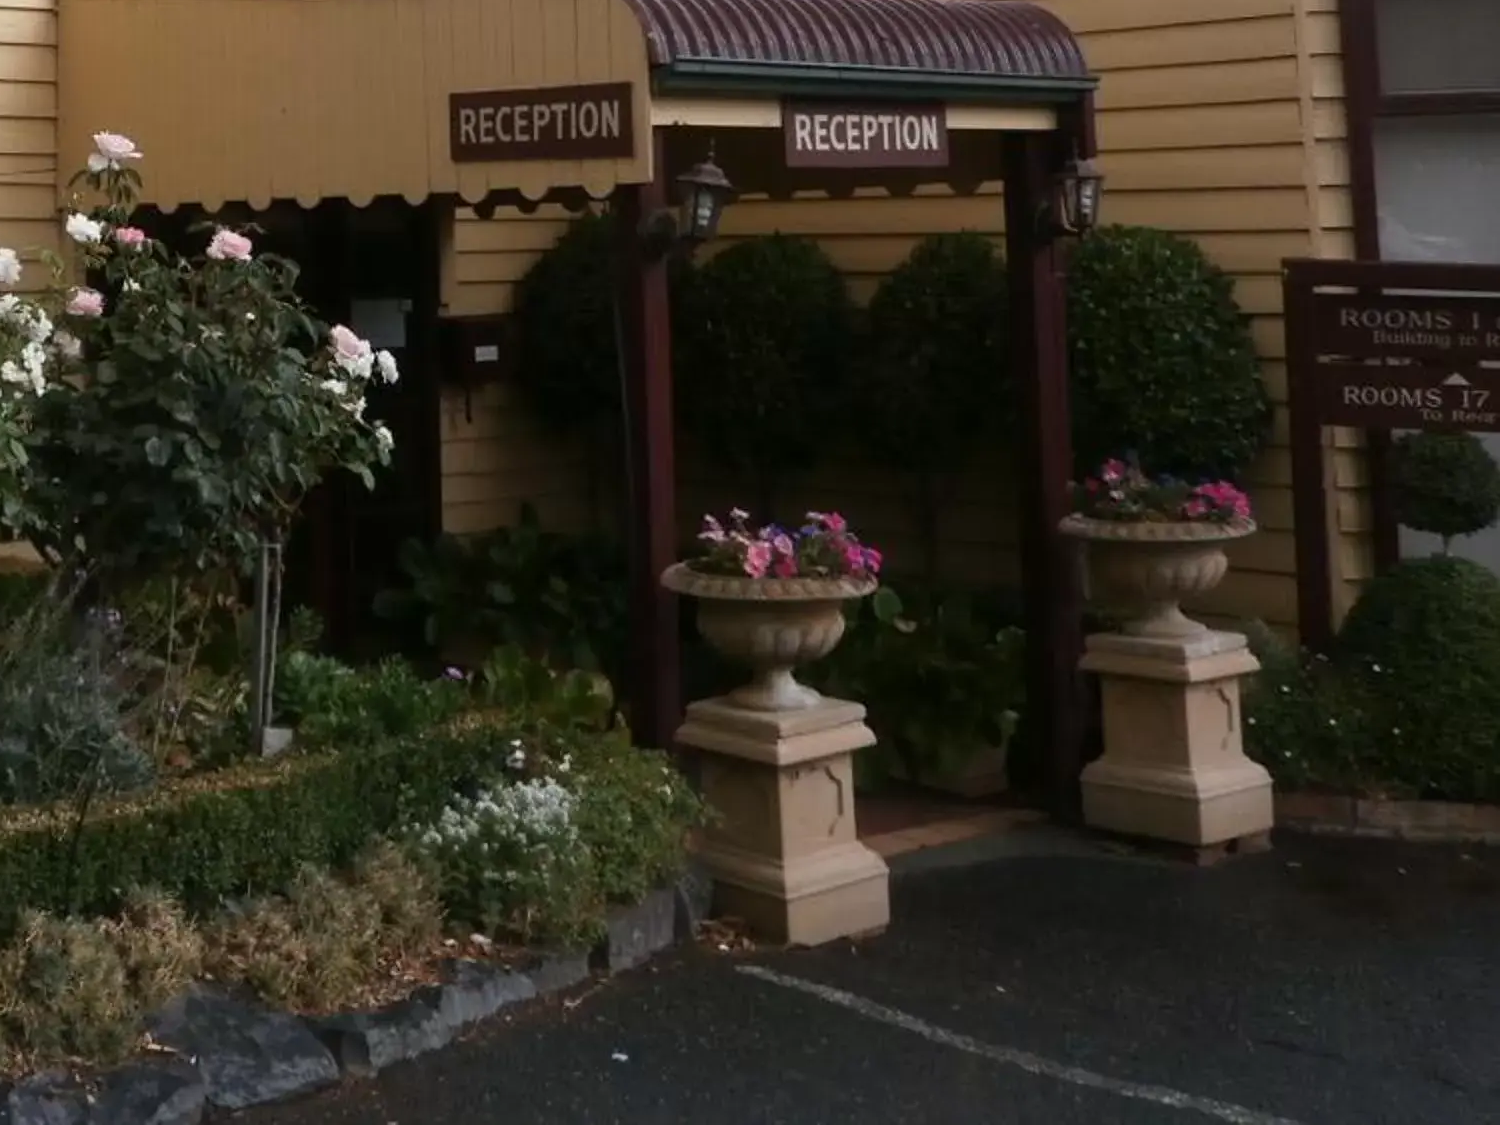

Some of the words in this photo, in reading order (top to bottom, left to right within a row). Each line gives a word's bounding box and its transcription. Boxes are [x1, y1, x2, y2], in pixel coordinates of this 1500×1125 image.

[458, 100, 621, 144] RECEPTION
[795, 114, 938, 151] RECEPTION
[1340, 308, 1453, 330] ROOMS
[1343, 386, 1443, 408] ROOMS
